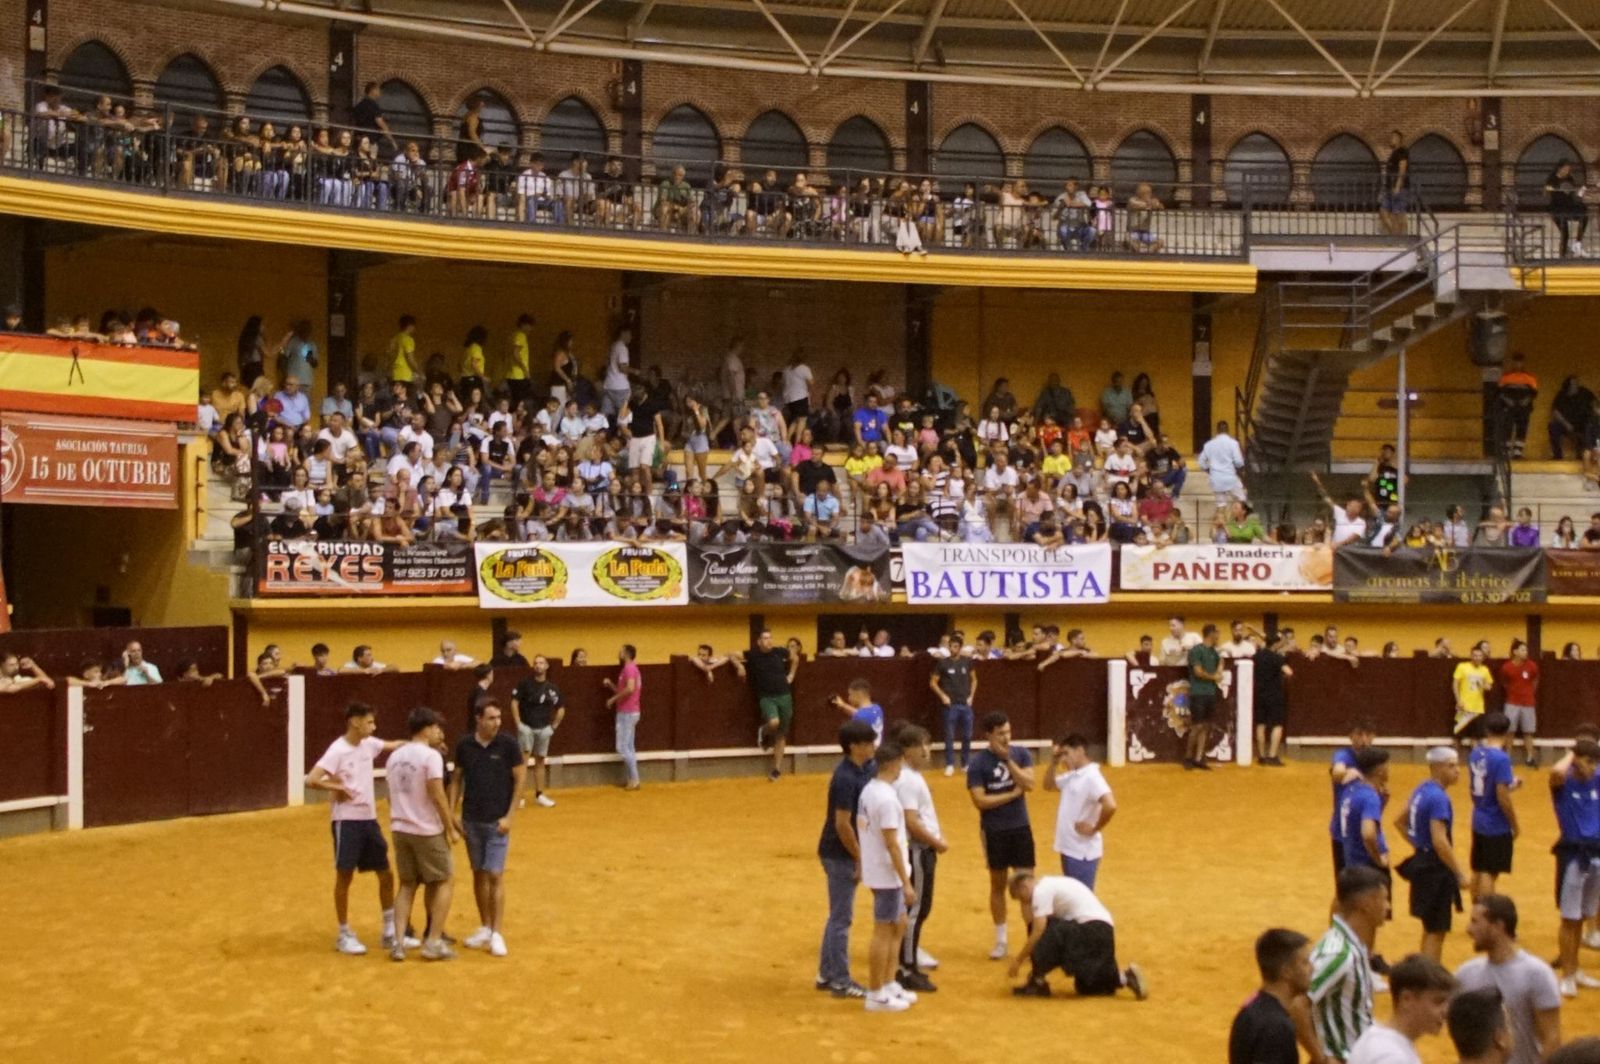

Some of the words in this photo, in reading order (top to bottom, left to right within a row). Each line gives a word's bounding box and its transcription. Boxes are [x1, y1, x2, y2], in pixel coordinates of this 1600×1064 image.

[32, 9, 42, 24] 4
[334, 52, 343, 66] 4
[626, 80, 636, 95] 4
[909, 101, 919, 114] 4
[1195, 111, 1205, 126] 4
[1486, 114, 1497, 128] 3
[56, 438, 108, 453] ASOCIACIÓN
[109, 441, 148, 455] TAURINA
[31, 455, 49, 480] 15
[56, 462, 77, 481] DE
[82, 458, 171, 485] OCTUBRE
[621, 548, 653, 556] FRUTAS
[940, 547, 1074, 564] TRANSPORTES
[266, 554, 384, 583] REYES
[496, 560, 515, 578] La
[610, 559, 629, 577] La
[1152, 556, 1272, 581] PAÑERO
[911, 570, 1105, 598] BAUTISTA
